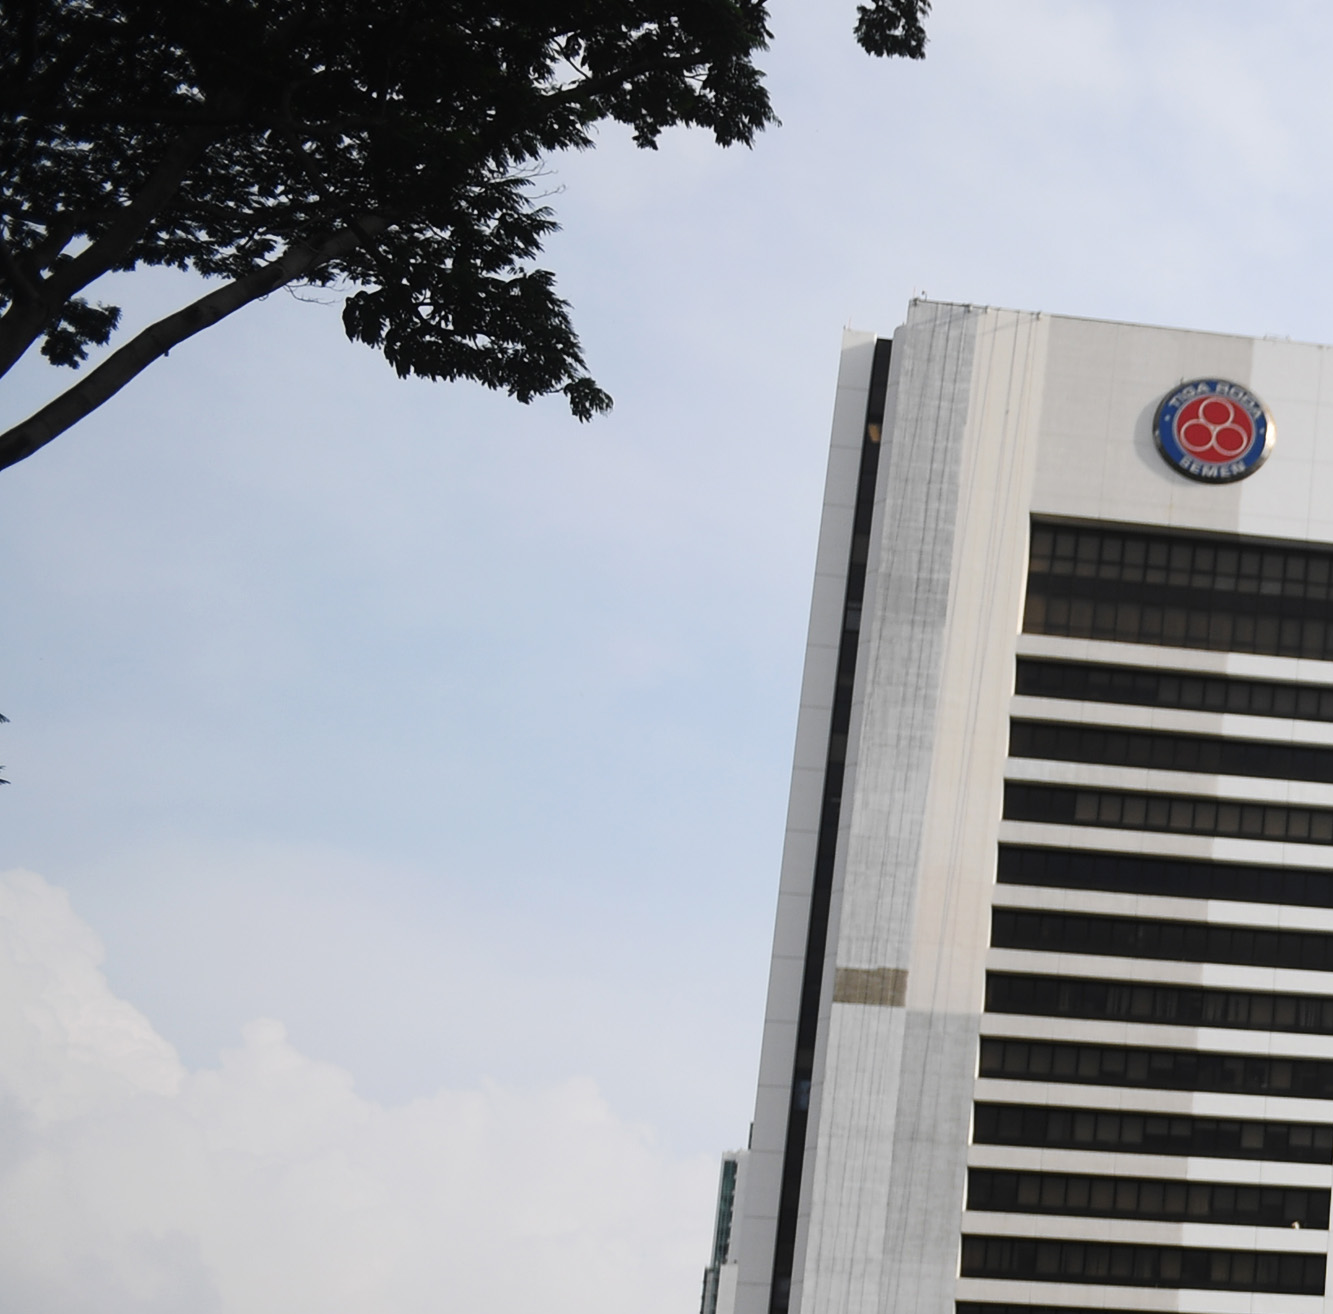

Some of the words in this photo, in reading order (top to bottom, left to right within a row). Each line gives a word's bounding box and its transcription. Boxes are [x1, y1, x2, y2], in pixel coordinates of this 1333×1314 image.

[1168, 382, 1210, 409] TIGA
[1214, 381, 1262, 420] RODA
[1179, 454, 1247, 478] SEMEN
